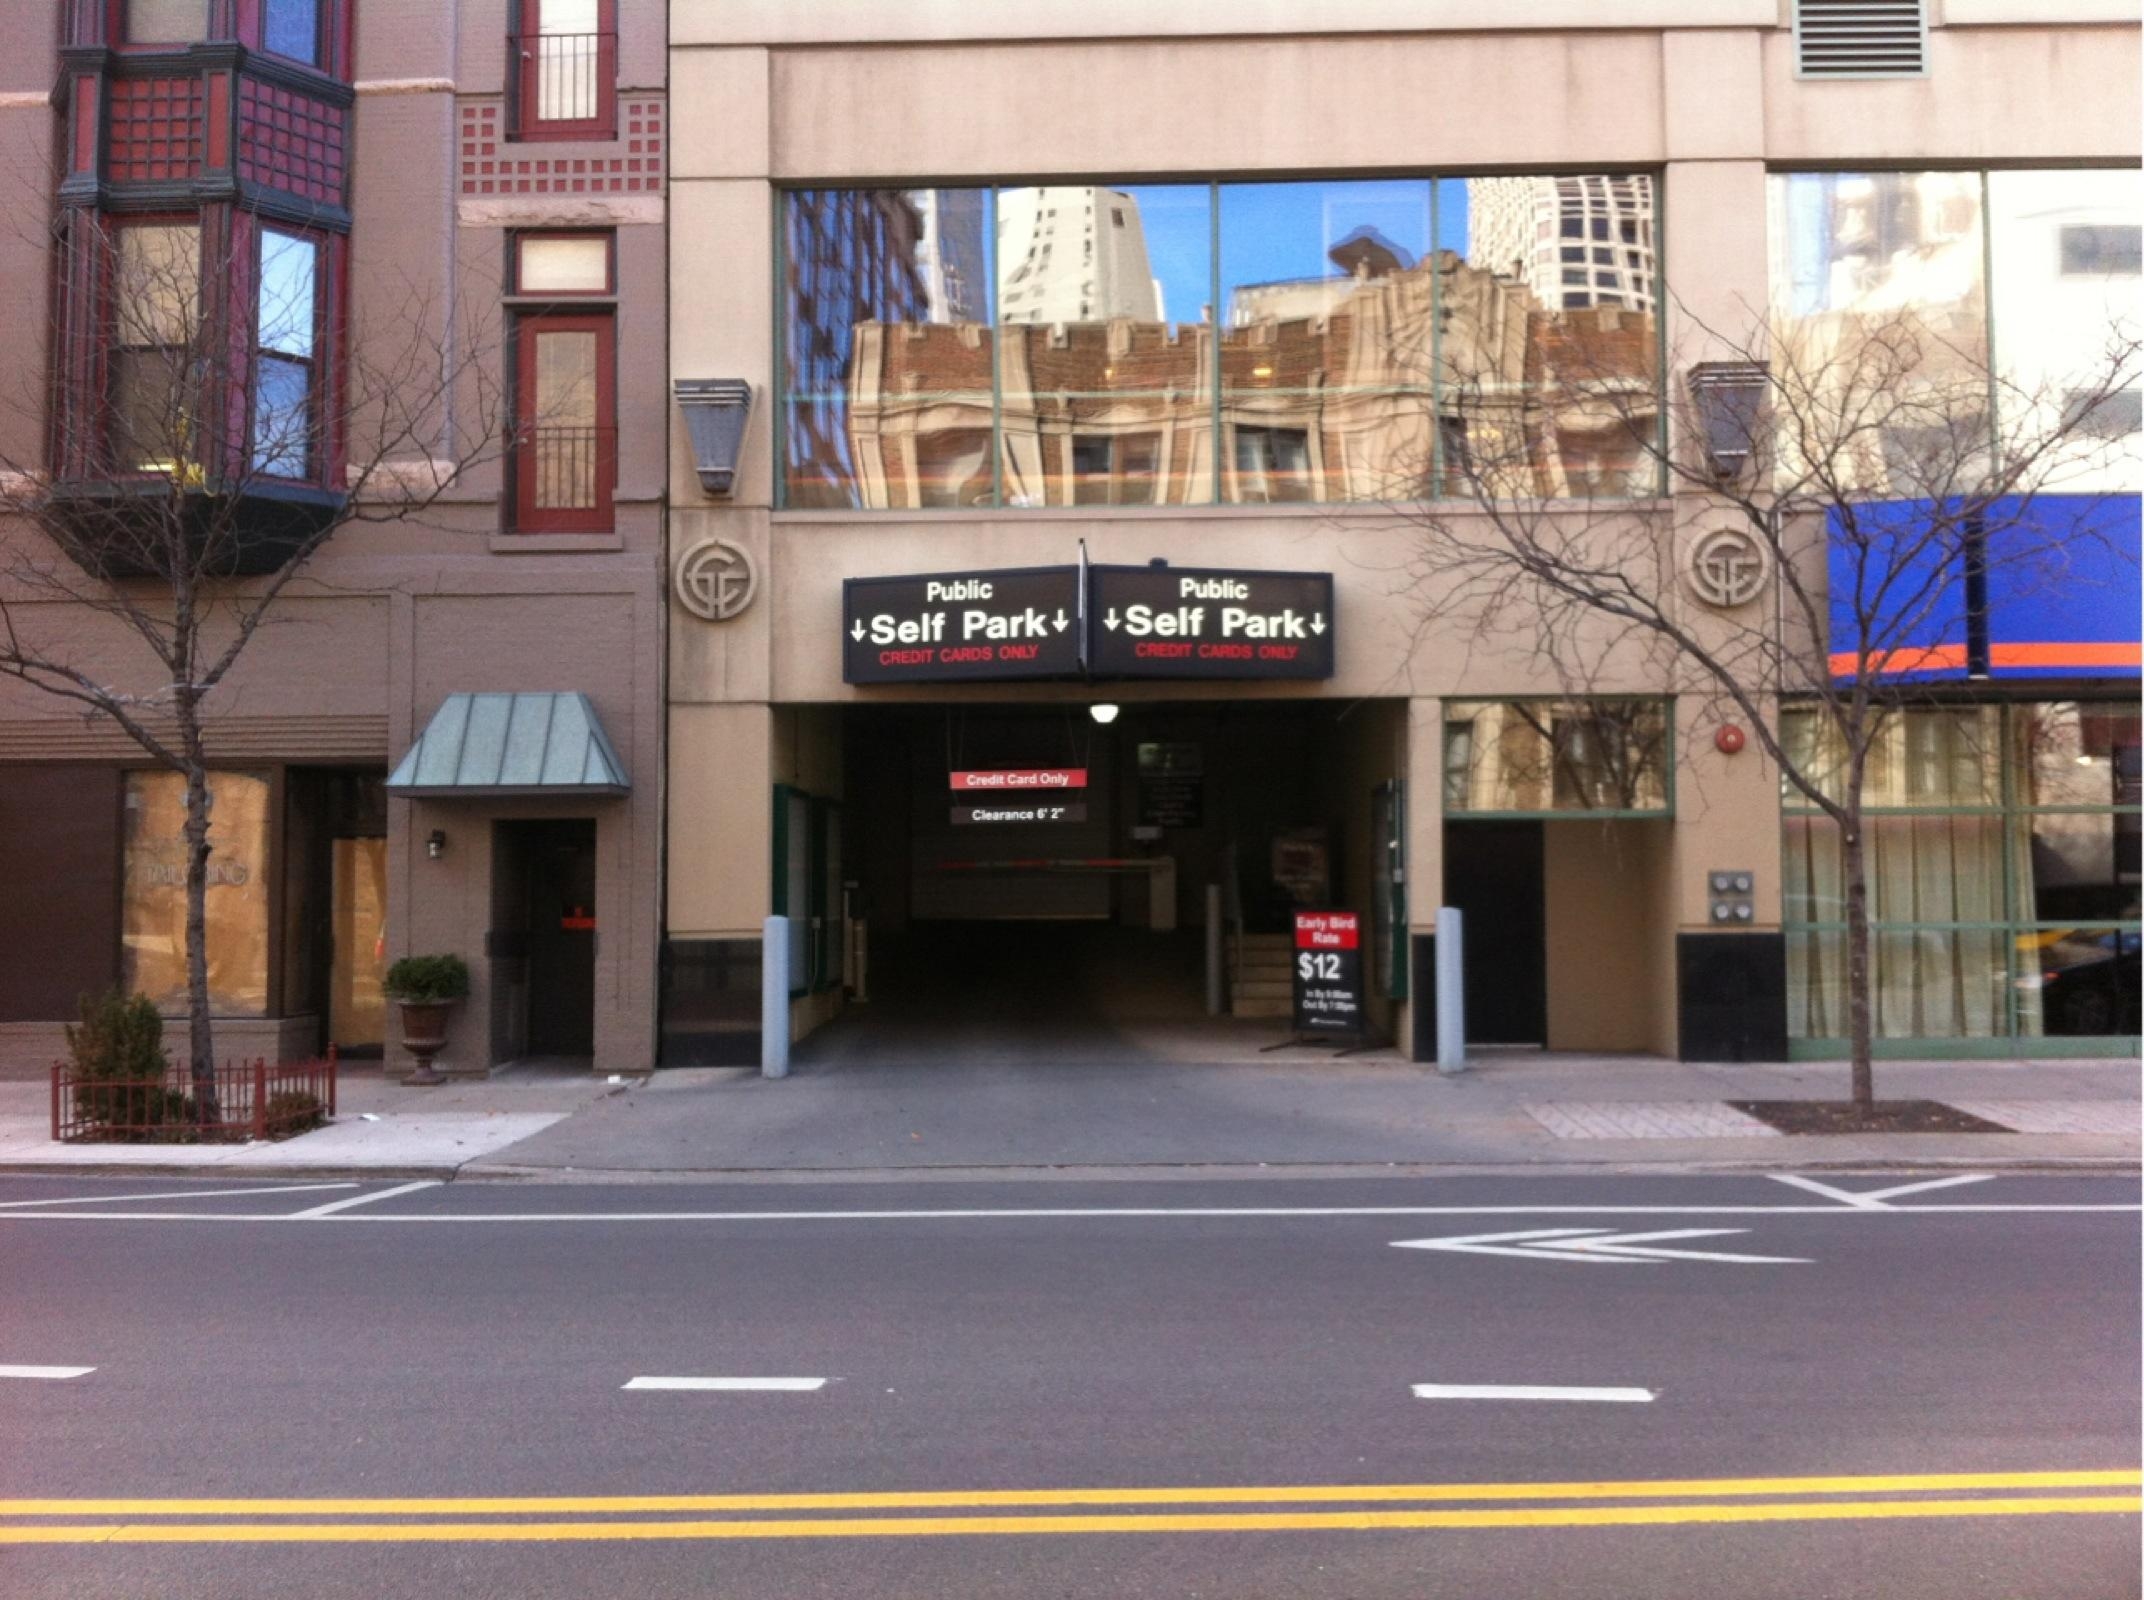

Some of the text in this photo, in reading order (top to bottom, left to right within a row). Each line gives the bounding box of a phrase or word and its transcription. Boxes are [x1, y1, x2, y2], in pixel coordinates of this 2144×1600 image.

[927, 580, 993, 603] Public
[1180, 577, 1249, 600] Public
[870, 607, 1048, 645] Self Park
[1125, 604, 1305, 638] Self Park
[879, 644, 1039, 666] CREDIT CARDS ONLY
[1135, 641, 1299, 660] CREDIT CARDS ONLY
[966, 772, 1069, 787] Credit Card Only
[972, 809, 1034, 821] Clearance
[1296, 916, 1356, 931] Early Bird
[1312, 931, 1341, 944] Rate
[1298, 952, 1341, 981] $12
